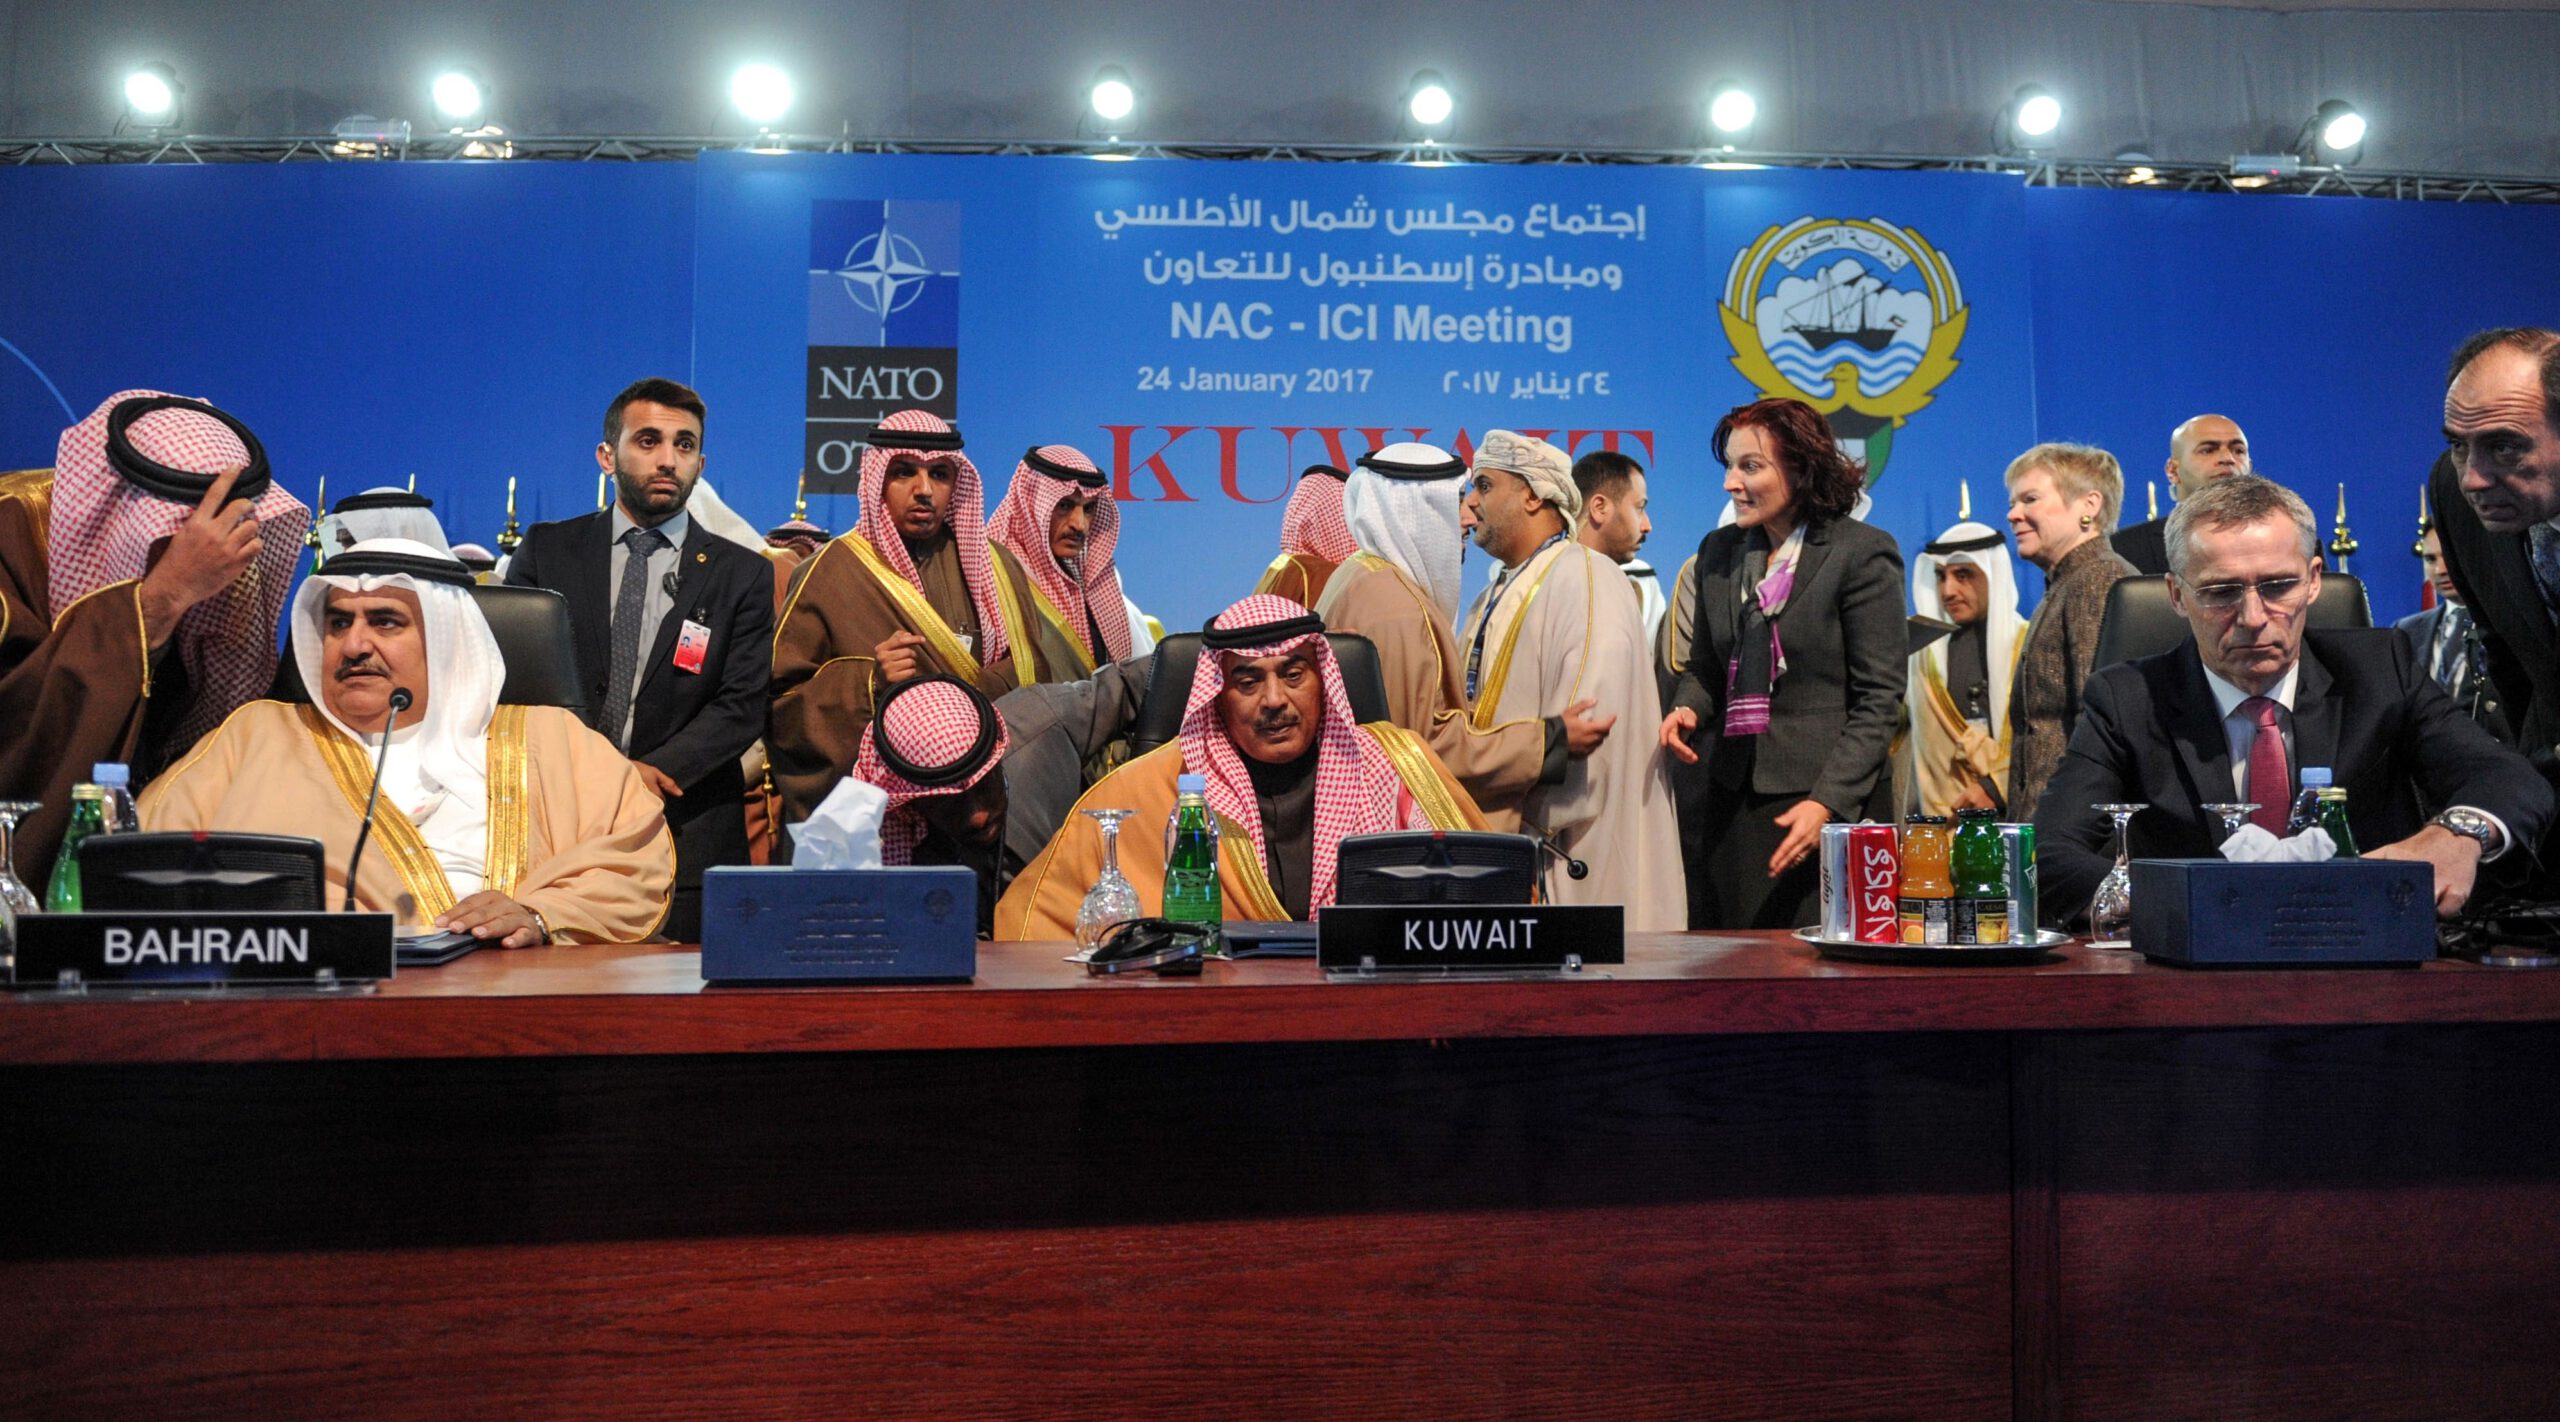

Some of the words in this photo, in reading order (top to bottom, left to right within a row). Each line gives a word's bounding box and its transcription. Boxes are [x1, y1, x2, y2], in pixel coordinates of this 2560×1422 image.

[1094, 193, 1262, 239] الأطلسي
[1270, 194, 1377, 235] شمال
[1385, 203, 1516, 237] مجلس
[1523, 204, 1646, 240] إجتماع
[1143, 249, 1292, 286] للتعاون
[1299, 253, 1474, 290] إسطنبول
[1482, 254, 1623, 291] ومبادرة
[1170, 302, 1274, 340] NAC
[1318, 303, 1378, 341] ICI
[1393, 304, 1573, 353] Meeting
[818, 365, 944, 402] NATO
[1137, 366, 1172, 391] 24
[1179, 367, 1298, 398] January
[1305, 368, 1374, 393] 2017
[1509, 371, 1571, 400] يناير
[103, 927, 309, 964] BAHRAIN
[1404, 918, 1539, 951] KUWAIT
